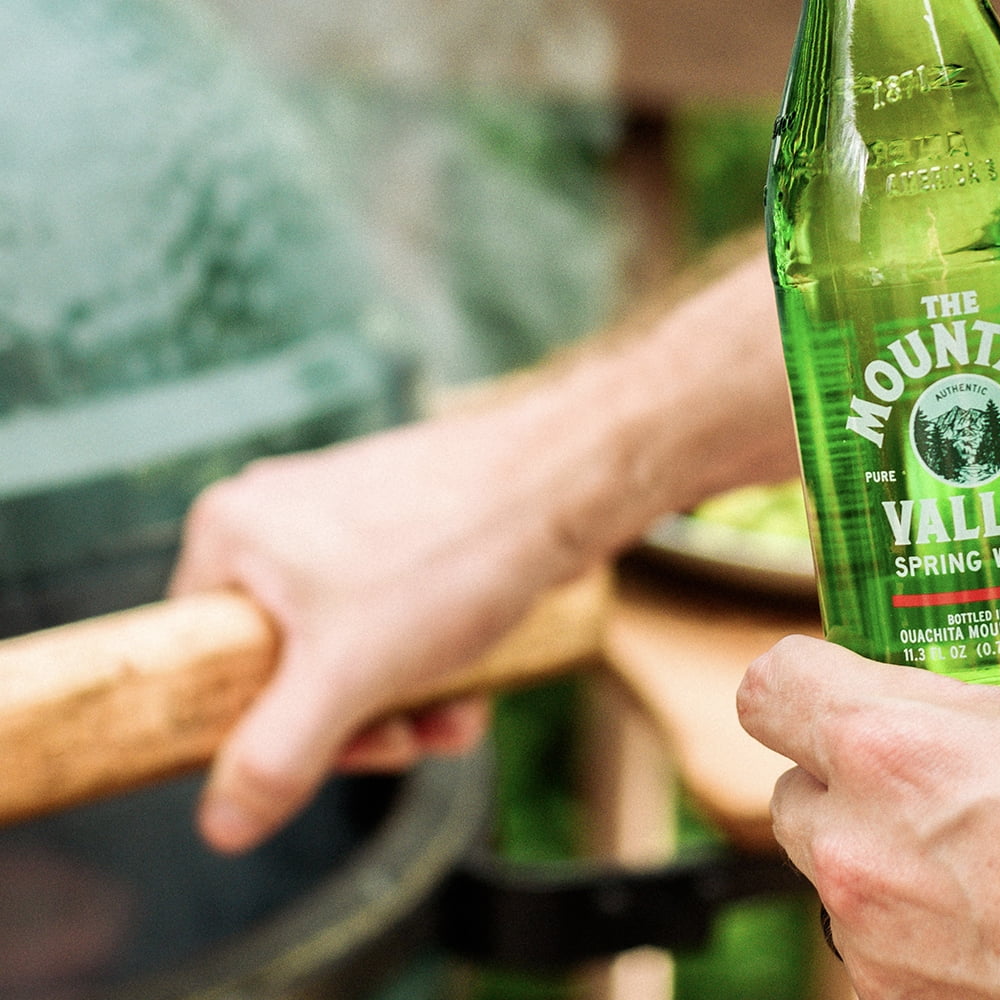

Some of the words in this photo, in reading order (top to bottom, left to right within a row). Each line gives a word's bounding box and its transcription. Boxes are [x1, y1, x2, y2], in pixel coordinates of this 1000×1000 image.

[920, 290, 979, 319] THE
[934, 383, 988, 402] AUTHENTIC
[865, 470, 897, 483] PURE
[895, 551, 982, 578] SPRING
[947, 610, 993, 626] BOTTLED
[900, 625, 964, 644] OUACHITA
[903, 647, 926, 662] 11.3
[950, 645, 967, 659] OZ
